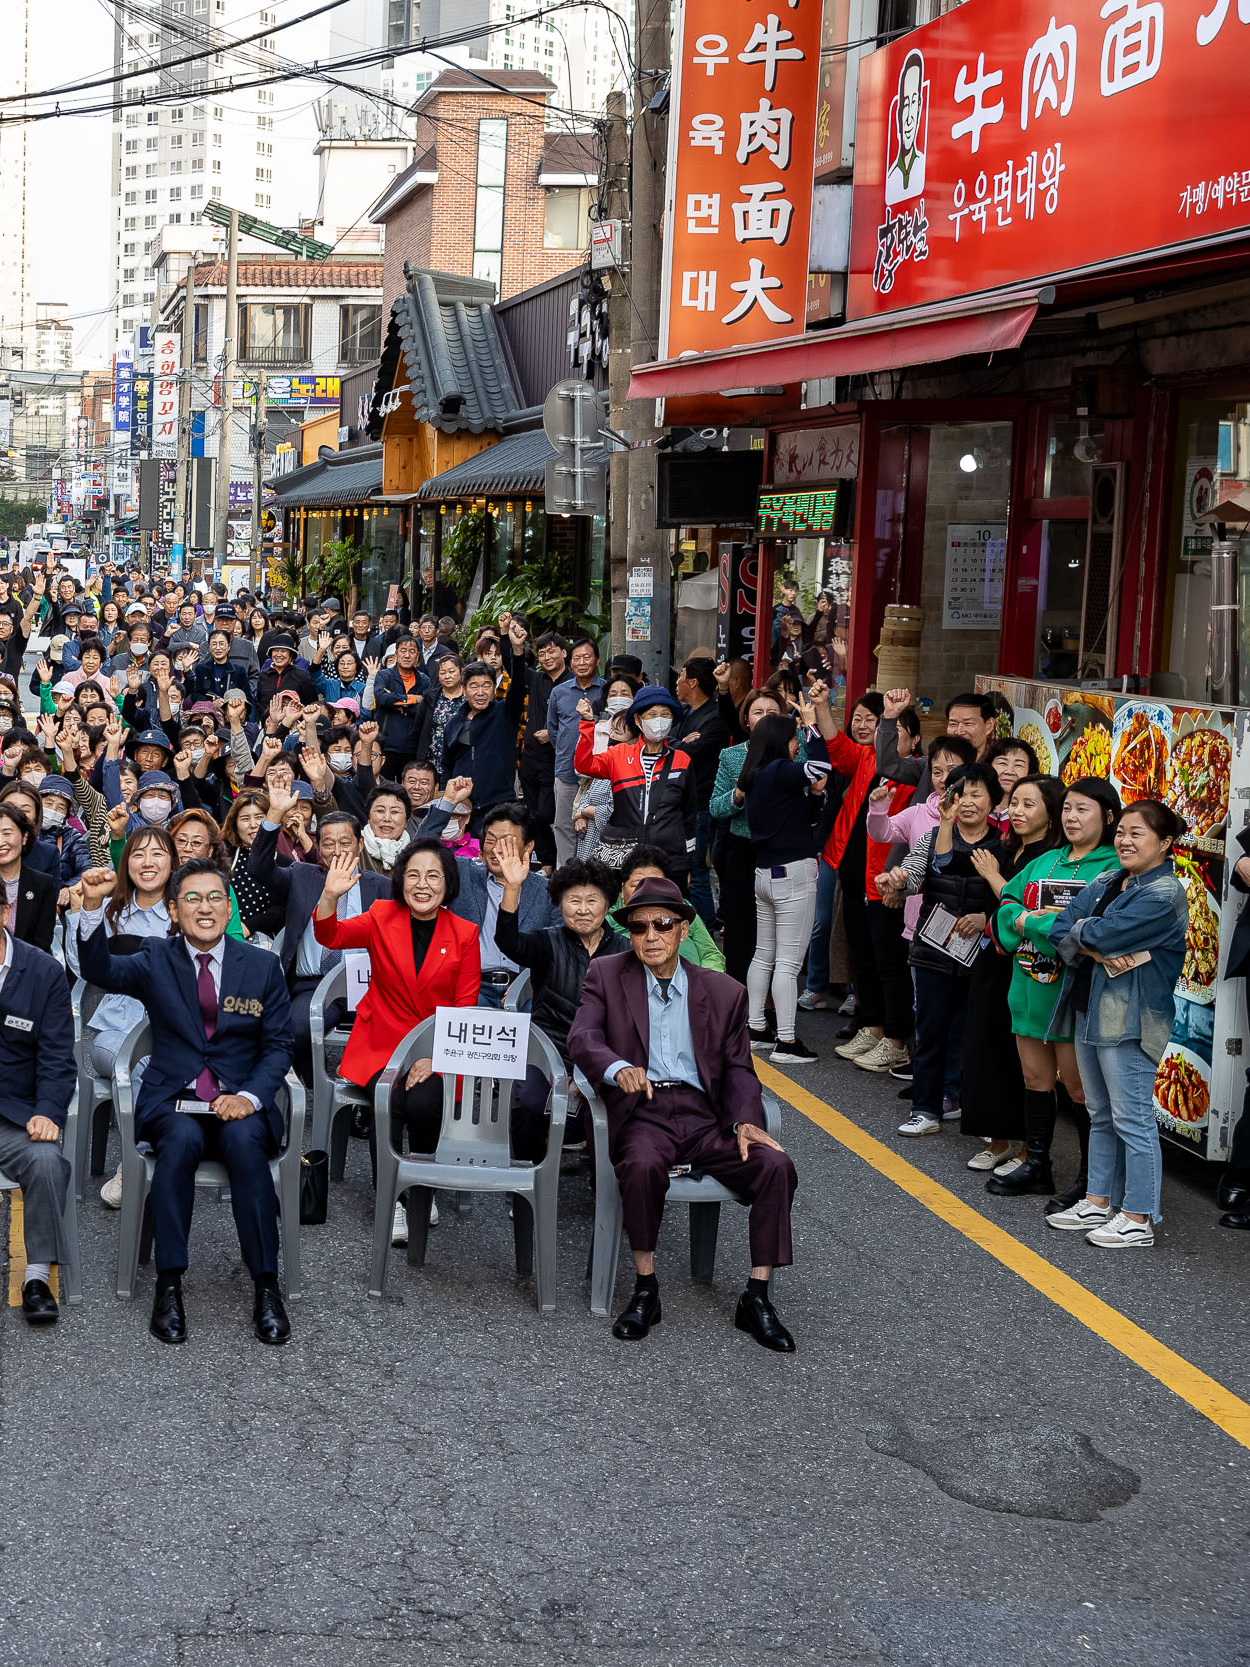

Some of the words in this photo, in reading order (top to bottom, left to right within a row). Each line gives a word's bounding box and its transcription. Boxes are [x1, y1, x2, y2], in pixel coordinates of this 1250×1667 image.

[721, 13, 807, 348] 牛肉面大
[947, 143, 1066, 242] 우육면대왕
[678, 34, 731, 358] 우육면대
[976, 529, 992, 541] 10
[223, 995, 264, 1018] 오신환
[447, 1021, 517, 1048] 내빈석
[444, 1048, 464, 1058] 추윤구
[467, 1050, 501, 1061] 광진구의회
[503, 1053, 518, 1063] 의장
